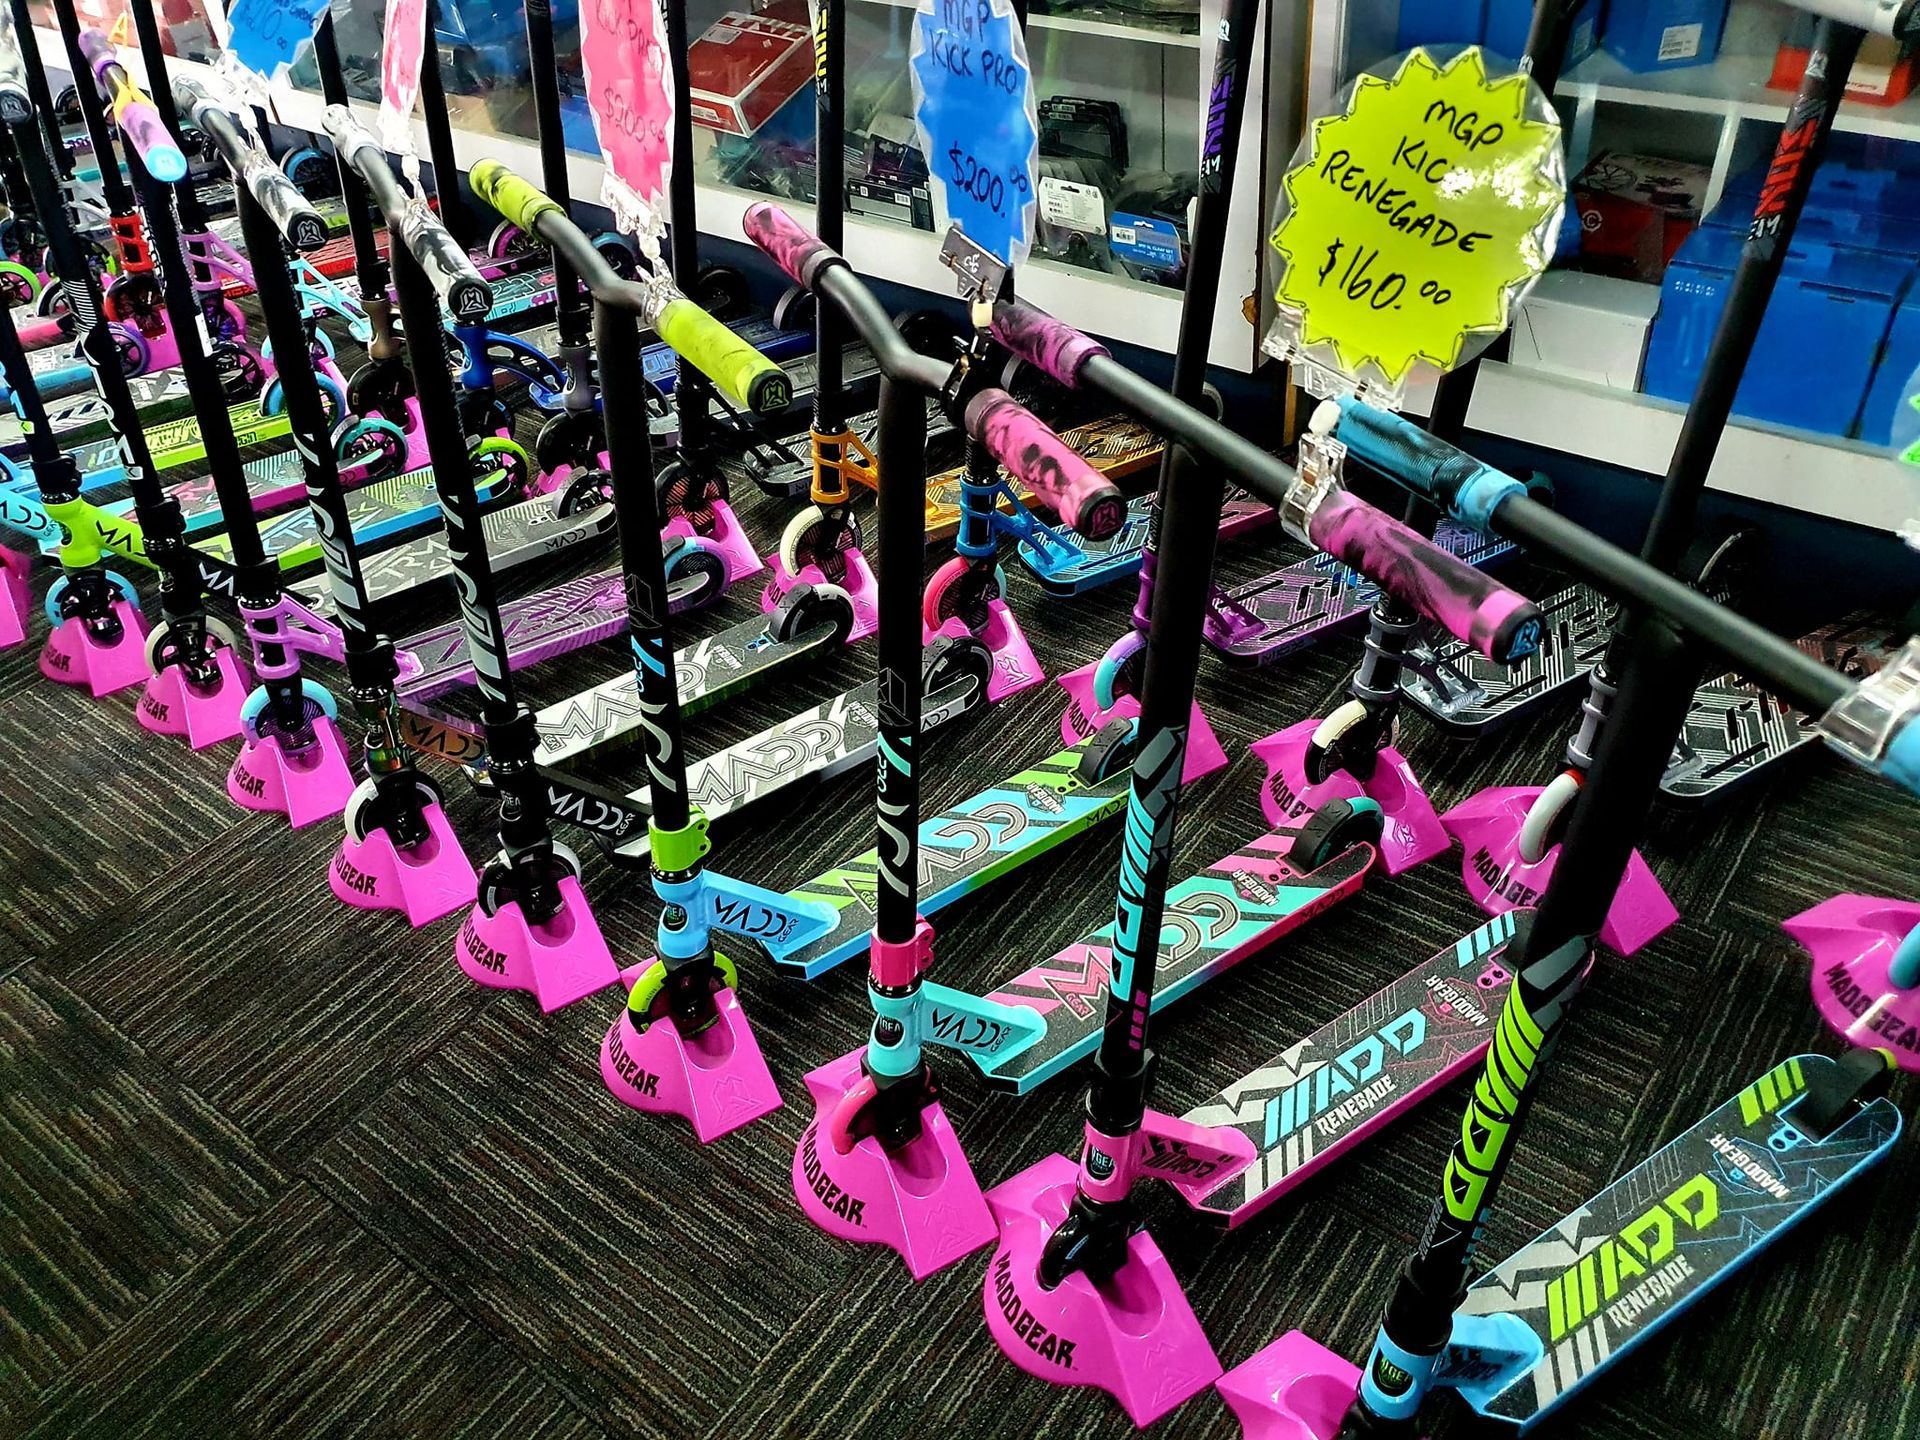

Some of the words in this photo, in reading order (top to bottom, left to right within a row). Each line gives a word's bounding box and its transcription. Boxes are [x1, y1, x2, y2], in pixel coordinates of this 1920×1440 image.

[929, 29, 973, 77] KICK
[981, 50, 1018, 95] PRO
[1424, 100, 1503, 151] MGP
[1392, 136, 1460, 190] KIC
[1320, 150, 1493, 253] RENEGADE
[410, 718, 488, 761] MADD
[921, 708, 950, 733] ADD
[548, 786, 624, 829] MADD
[616, 812, 636, 836] GEAR
[714, 895, 787, 937] MADD
[778, 917, 800, 943] GEAR
[932, 1008, 1000, 1048] MADD
[992, 1025, 1012, 1052] GEAR
[1315, 1074, 1397, 1137] RENEGADE
[1606, 1253, 1695, 1329] RENEGADE
